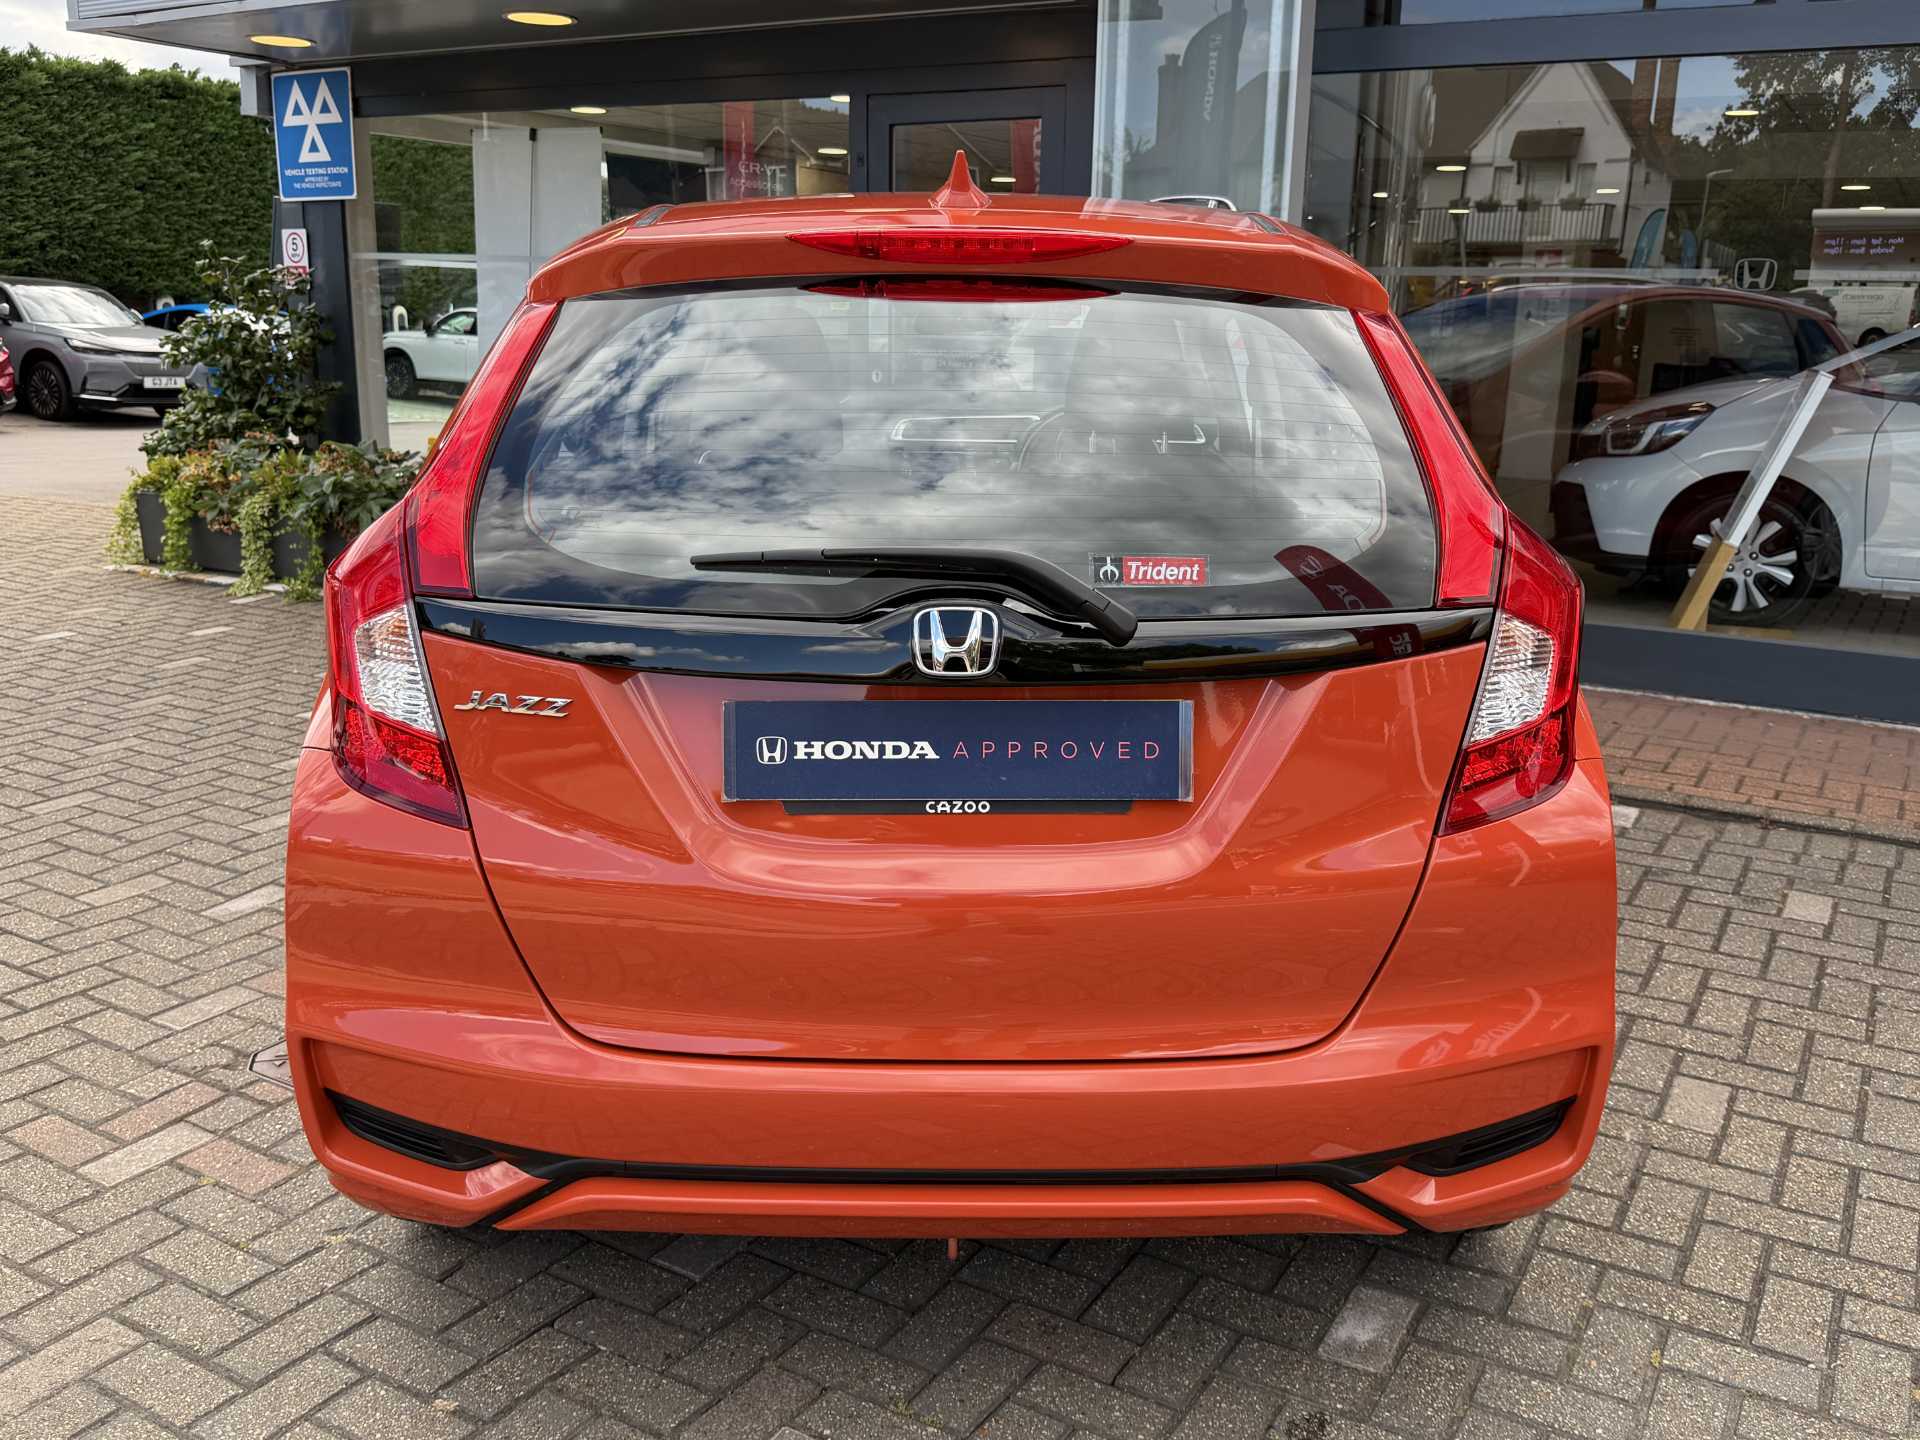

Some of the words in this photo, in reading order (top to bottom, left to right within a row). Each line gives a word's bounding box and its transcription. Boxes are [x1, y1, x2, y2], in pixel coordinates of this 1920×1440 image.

[284, 168, 305, 176] VEHICLE
[306, 167, 327, 175] TESTING
[327, 166, 349, 174] STATION
[291, 237, 298, 251] 5
[1128, 561, 1200, 580] Trident
[453, 690, 573, 717] JAZZ
[793, 741, 940, 760] HONDA
[953, 741, 1160, 760] APPROVED
[925, 801, 991, 813] CAZOO
